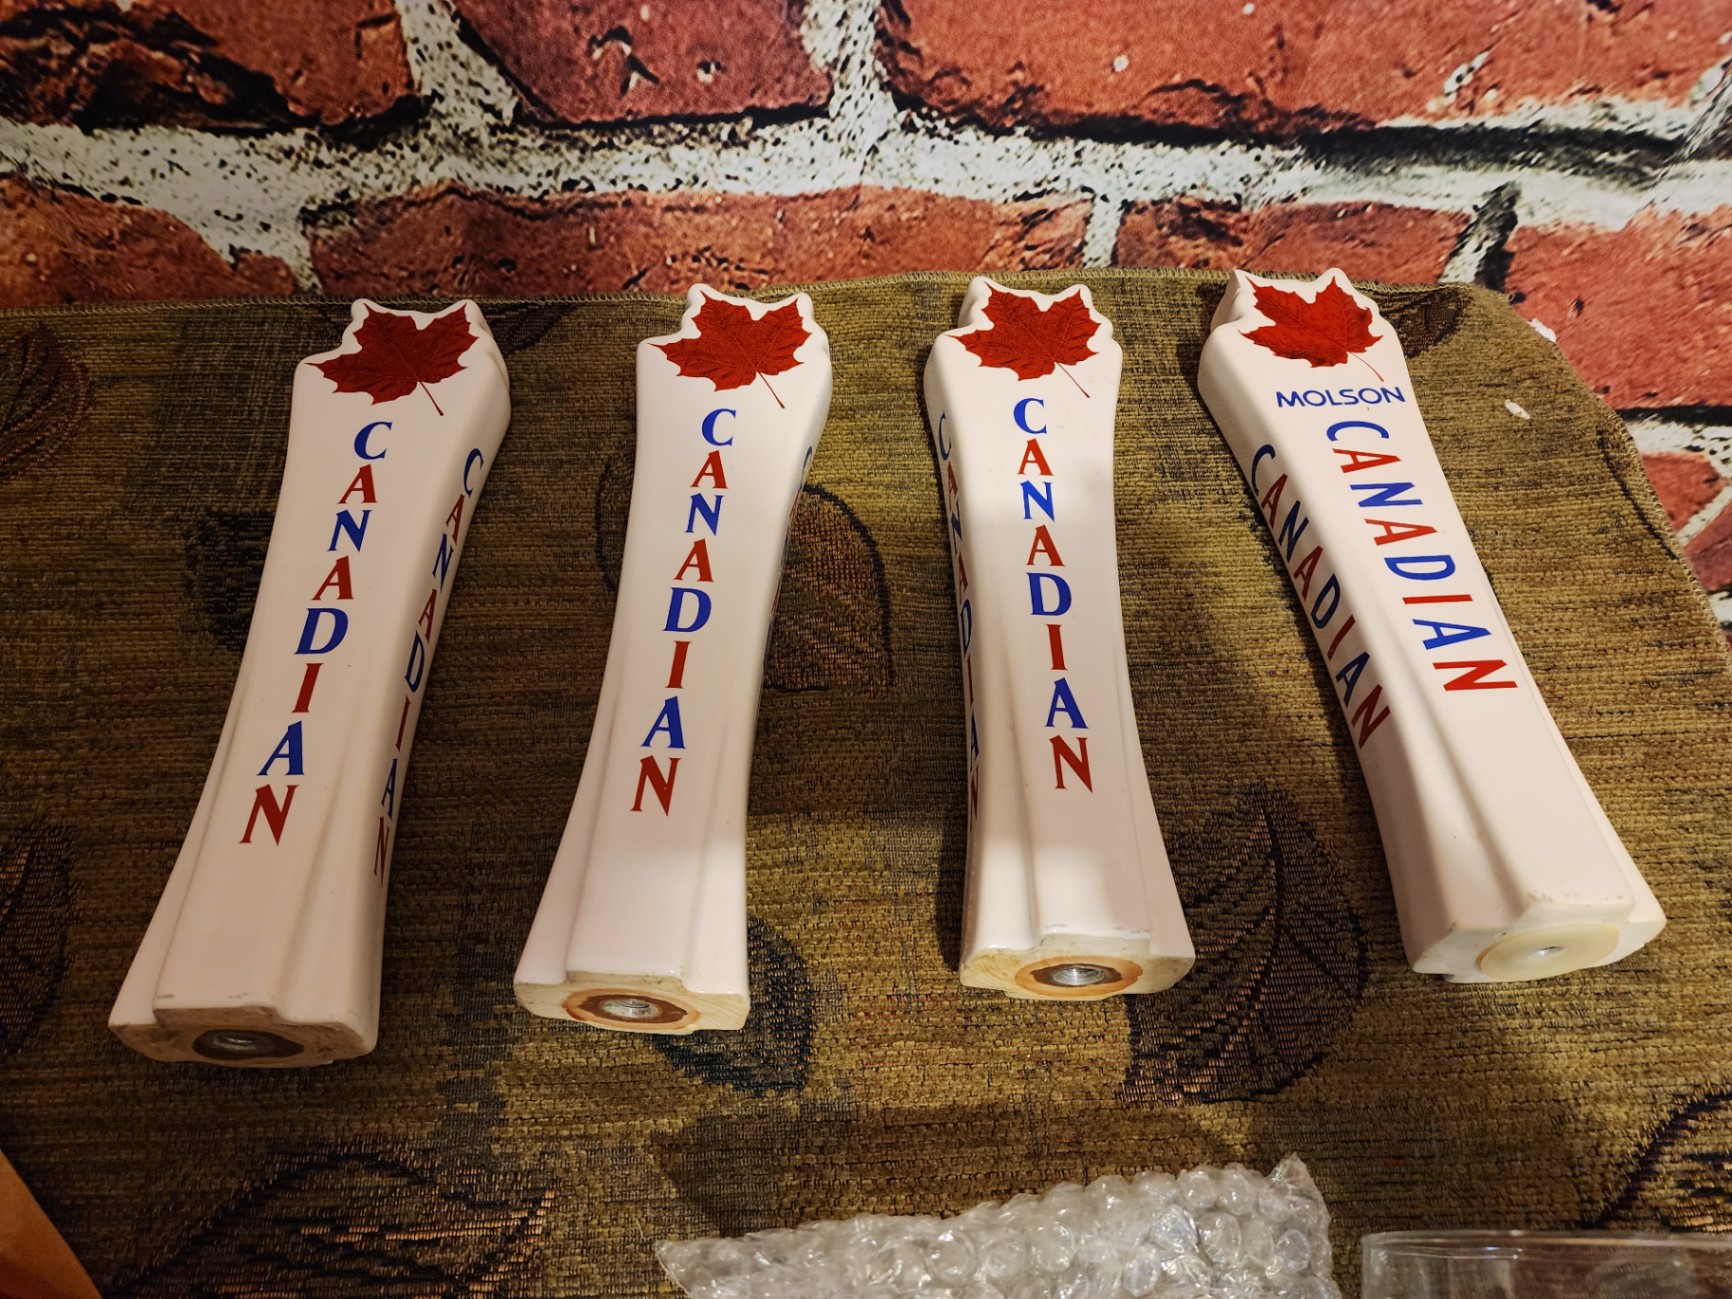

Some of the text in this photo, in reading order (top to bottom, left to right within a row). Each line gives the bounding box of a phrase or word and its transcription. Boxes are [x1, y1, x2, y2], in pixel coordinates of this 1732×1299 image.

[1013, 398, 1093, 793] CANADIAN
[1252, 444, 1390, 750] CANADIAN
[1276, 386, 1406, 408] MOLSON
[1327, 421, 1518, 691] CANADIAN
[239, 421, 393, 845] CANADIAN
[373, 448, 484, 888] CANADIAN
[630, 409, 737, 816] CANADIAN
[938, 411, 979, 832] CANADIAN
